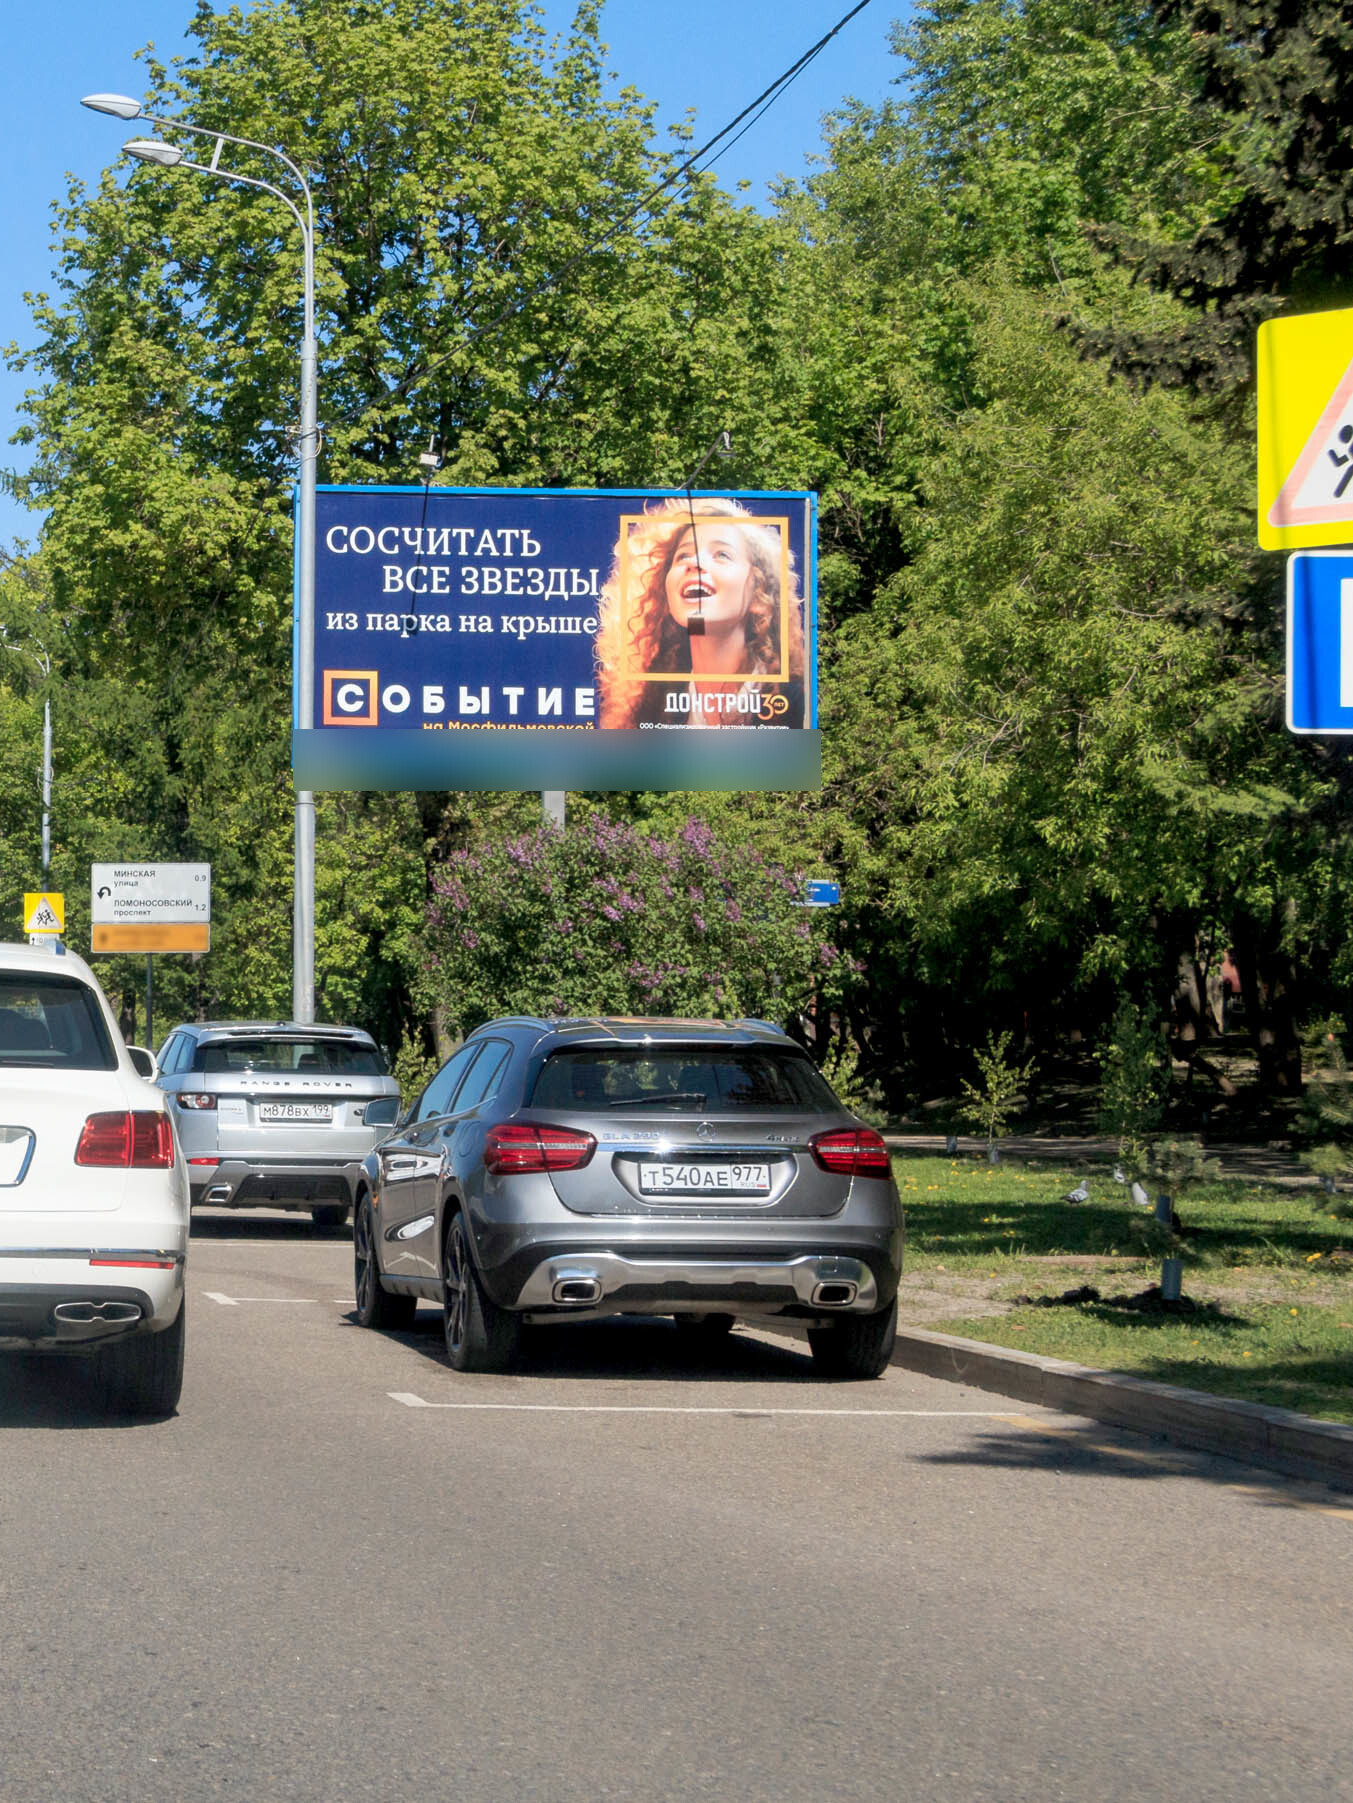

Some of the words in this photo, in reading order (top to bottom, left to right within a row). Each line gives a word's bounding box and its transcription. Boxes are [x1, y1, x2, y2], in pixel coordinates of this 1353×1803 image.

[325, 524, 542, 558] СОСЧИТАТЬ
[381, 564, 450, 595] ВСЕ
[460, 567, 599, 601] ЗВЕЗДЫ
[326, 612, 359, 632] из
[365, 614, 451, 638] парка
[459, 615, 504, 634] на
[507, 616, 598, 641] крыше
[335, 683, 596, 717] СОБЫТИЕ
[664, 689, 761, 713] ДОНСТРОЙ
[113, 870, 156, 878] МИНСКАЯ
[113, 880, 139, 888] улица
[113, 898, 193, 907] ЛОМОНОСОВСКИЙ
[648, 1166, 729, 1187] Т540АЕ
[732, 1166, 763, 1182] 977
